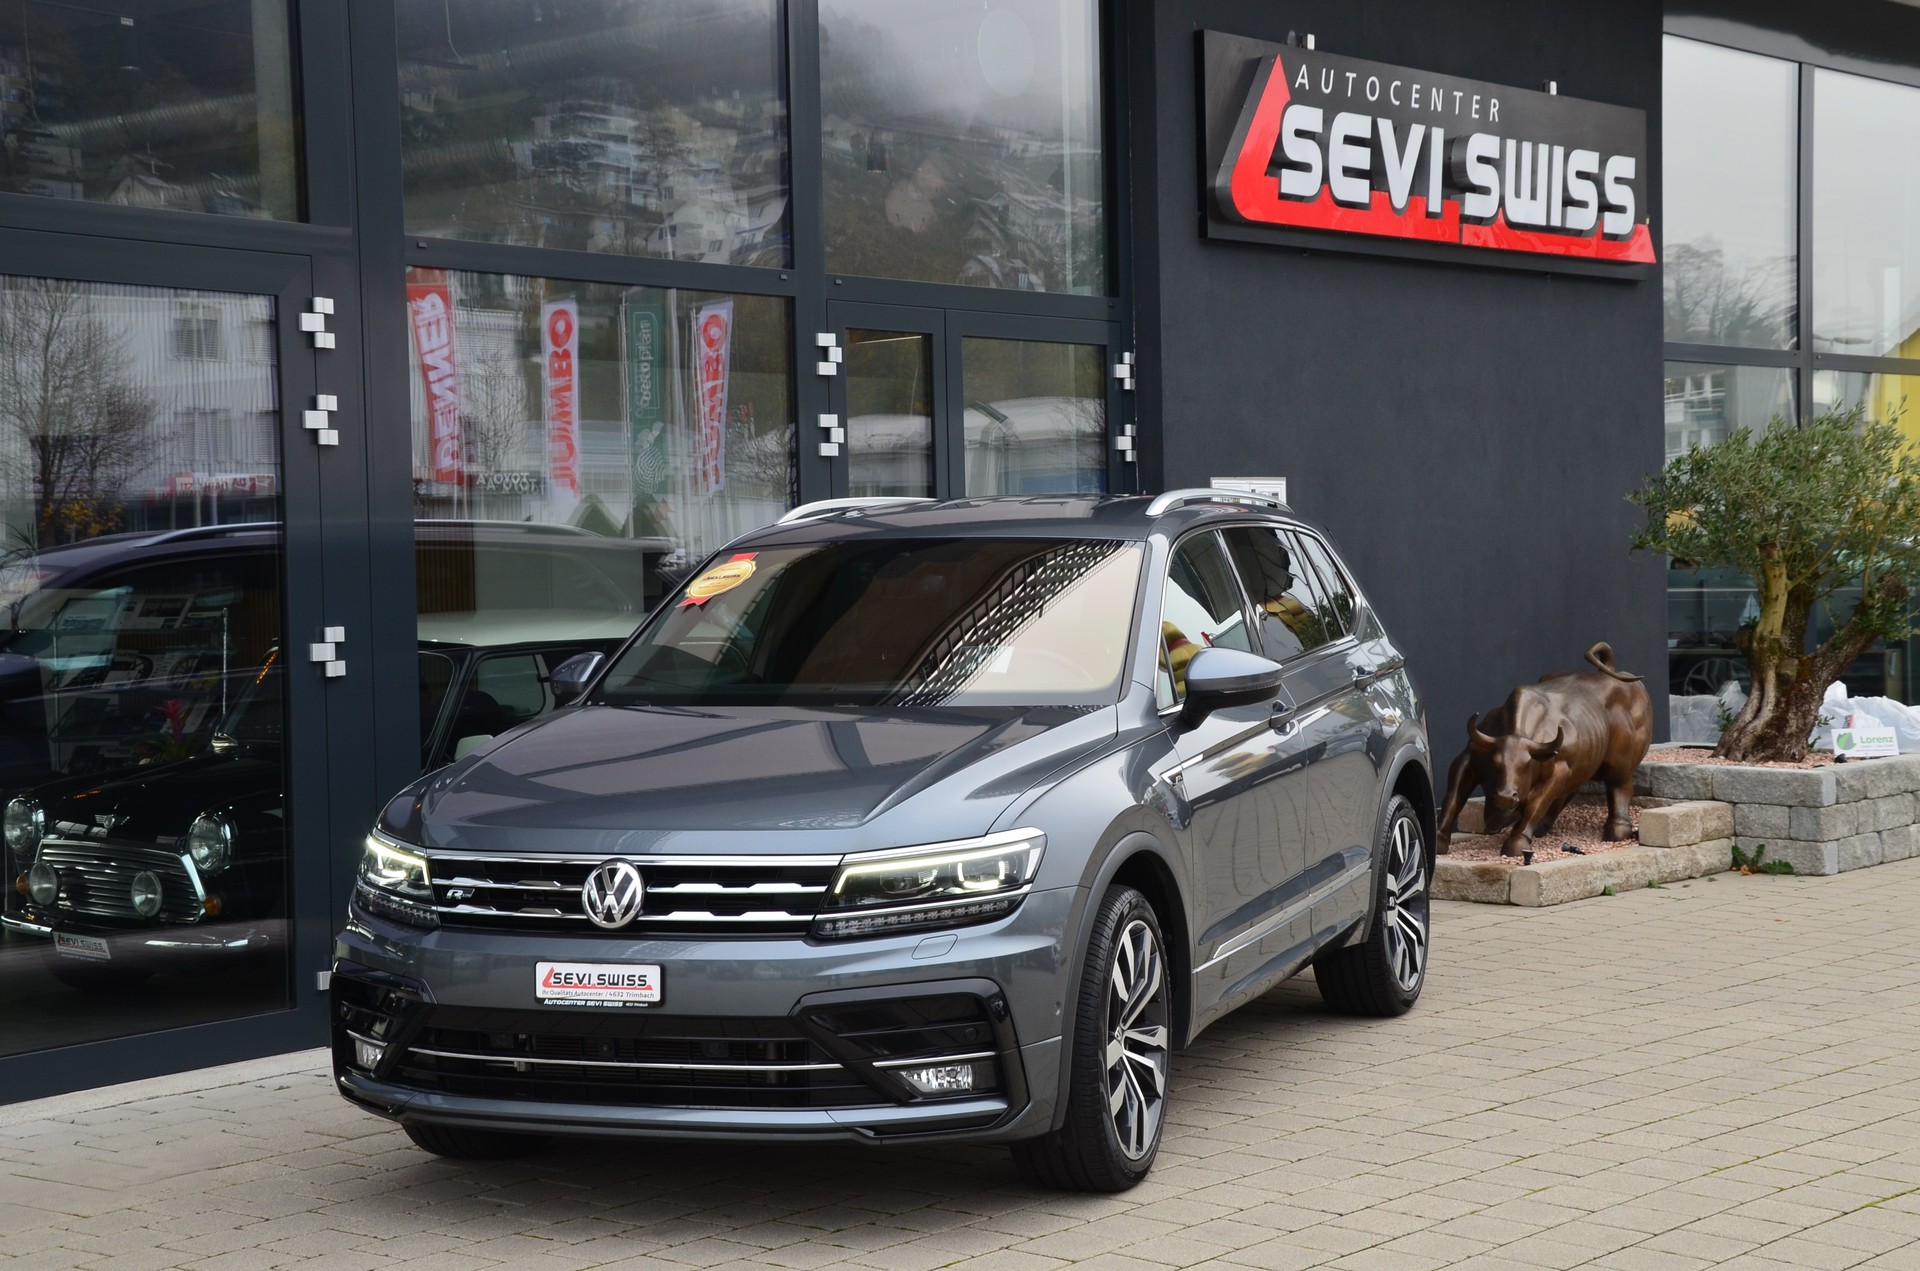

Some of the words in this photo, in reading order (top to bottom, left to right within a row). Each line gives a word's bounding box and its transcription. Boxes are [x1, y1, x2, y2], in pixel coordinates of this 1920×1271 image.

[1295, 63, 1500, 122] AUTOCENTER
[1280, 104, 1444, 213] SEVI
[1464, 133, 1636, 235] SWISS
[1860, 735, 1894, 744] Lorenz
[552, 972, 592, 986] SEVI
[596, 973, 647, 987] SWISS
[626, 991, 655, 999] Trimbach
